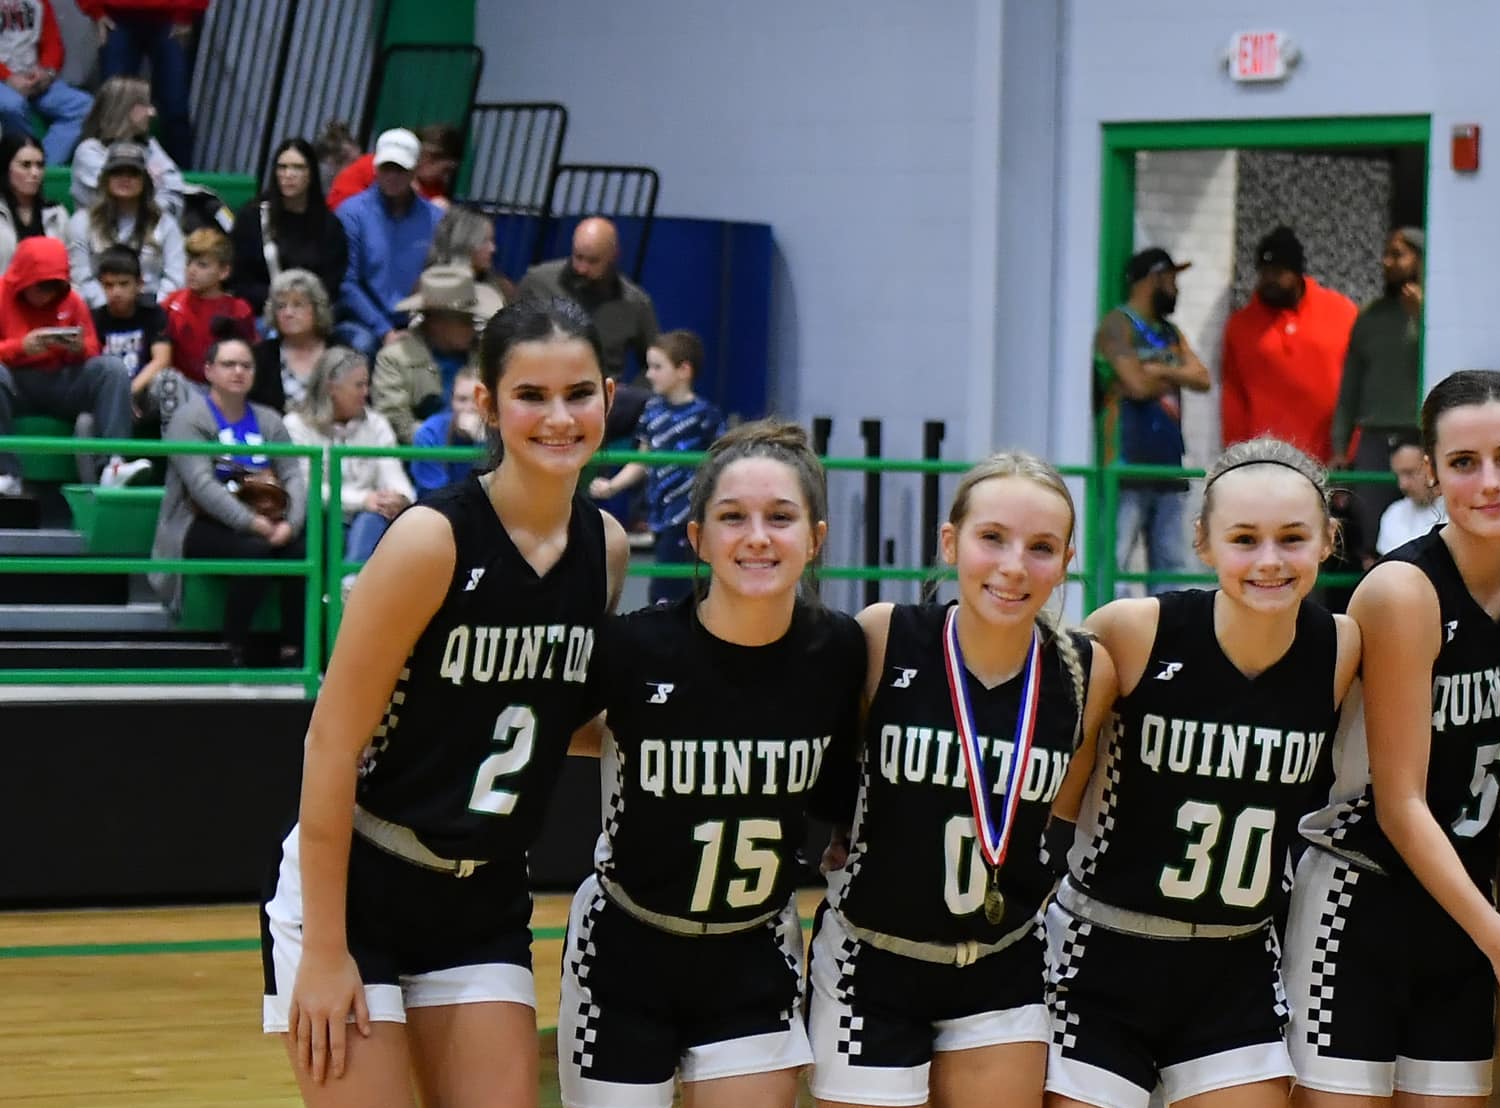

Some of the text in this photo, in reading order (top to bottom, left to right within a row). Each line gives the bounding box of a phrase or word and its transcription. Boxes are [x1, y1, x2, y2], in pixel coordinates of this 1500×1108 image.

[1239, 34, 1280, 75] EXIT
[468, 705, 535, 815] 2
[640, 735, 832, 797] QUINTON
[1139, 713, 1326, 784] QUINTON
[690, 819, 783, 913] 15
[1158, 800, 1276, 908] 30
